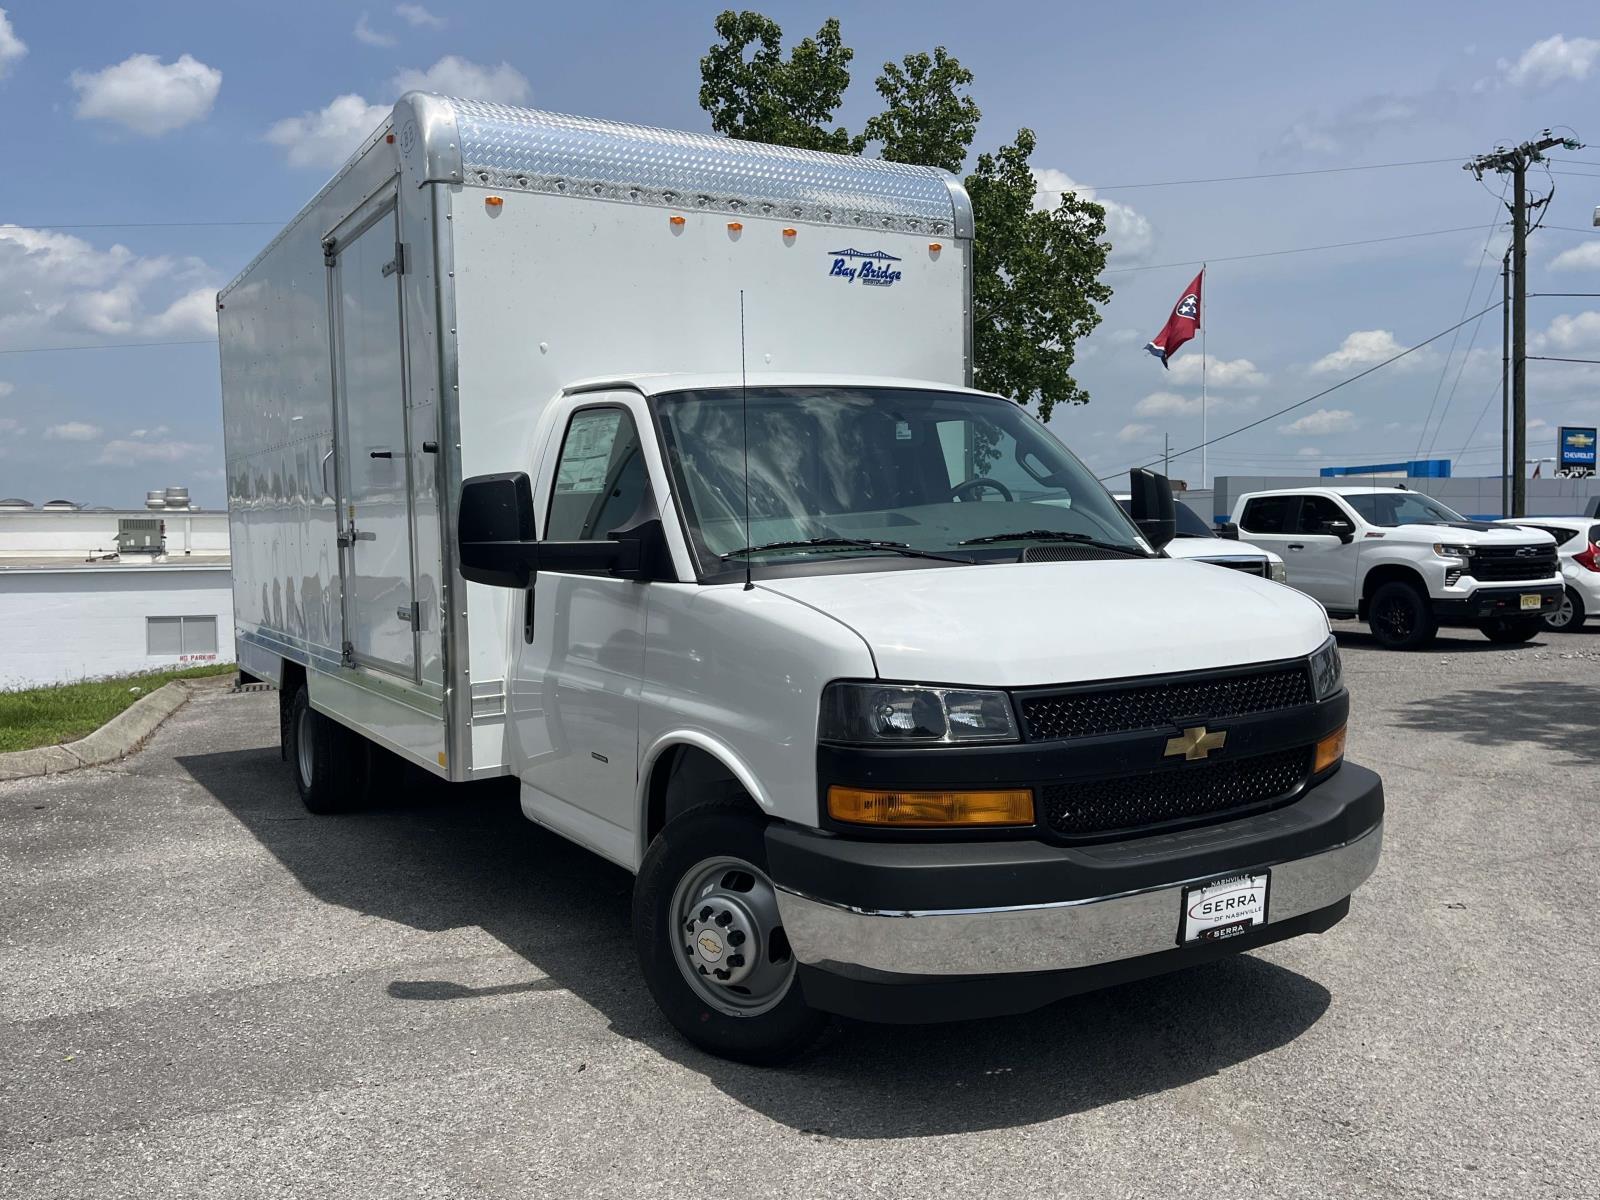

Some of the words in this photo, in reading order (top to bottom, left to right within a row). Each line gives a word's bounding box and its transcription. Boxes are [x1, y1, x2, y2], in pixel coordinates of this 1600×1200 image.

[829, 258, 857, 283] Bay
[857, 261, 902, 285] Bridge
[1563, 451, 1595, 459] CHEVROLET
[1211, 873, 1249, 887] NASHVILLE
[1202, 893, 1257, 915] SERRA
[1225, 906, 1262, 920] NASHVILLE
[1213, 925, 1244, 938] SERRA
